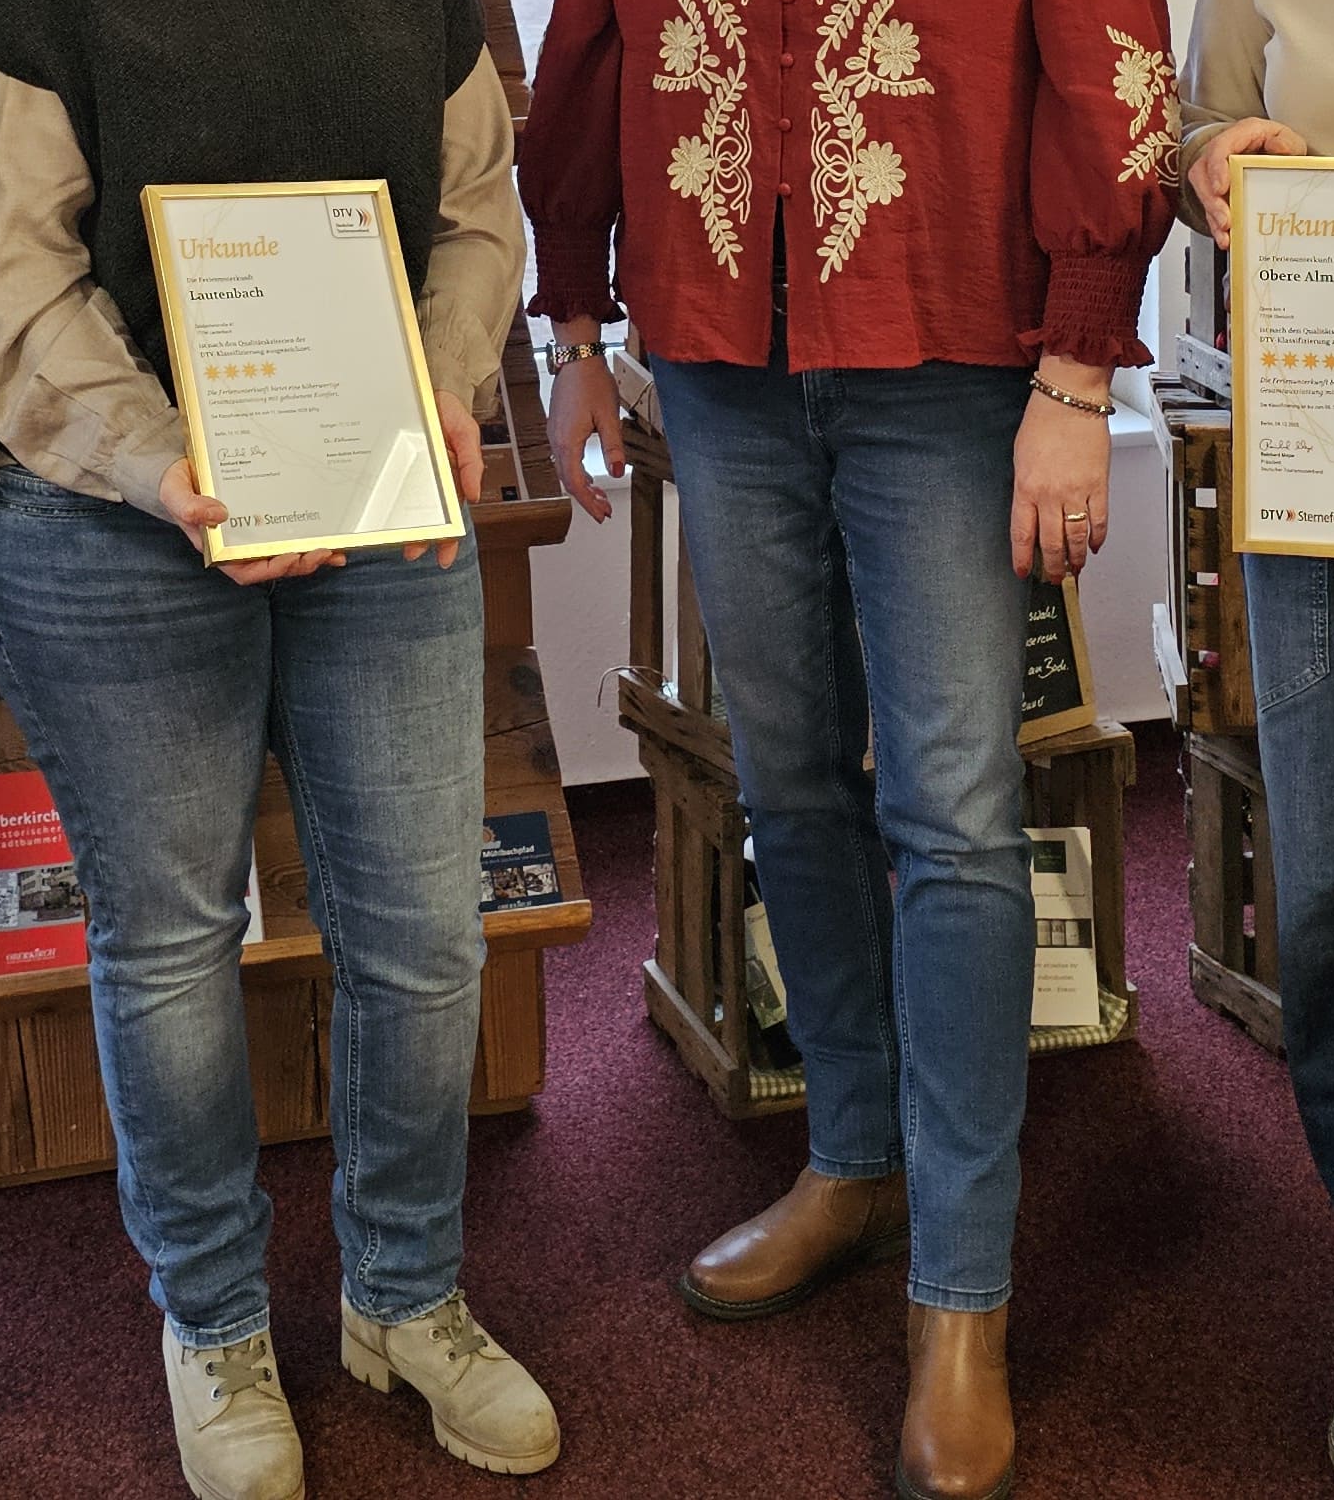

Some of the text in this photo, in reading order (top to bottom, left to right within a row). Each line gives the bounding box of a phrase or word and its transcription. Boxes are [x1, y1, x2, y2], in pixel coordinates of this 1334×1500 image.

[333, 208, 353, 218] DTV
[178, 236, 280, 260] Urkunde
[1259, 269, 1334, 283] Obere Alm
[189, 286, 264, 301] Lautenbach
[230, 510, 321, 528] DTV Sterneferien
[1260, 509, 1284, 521] DTV
